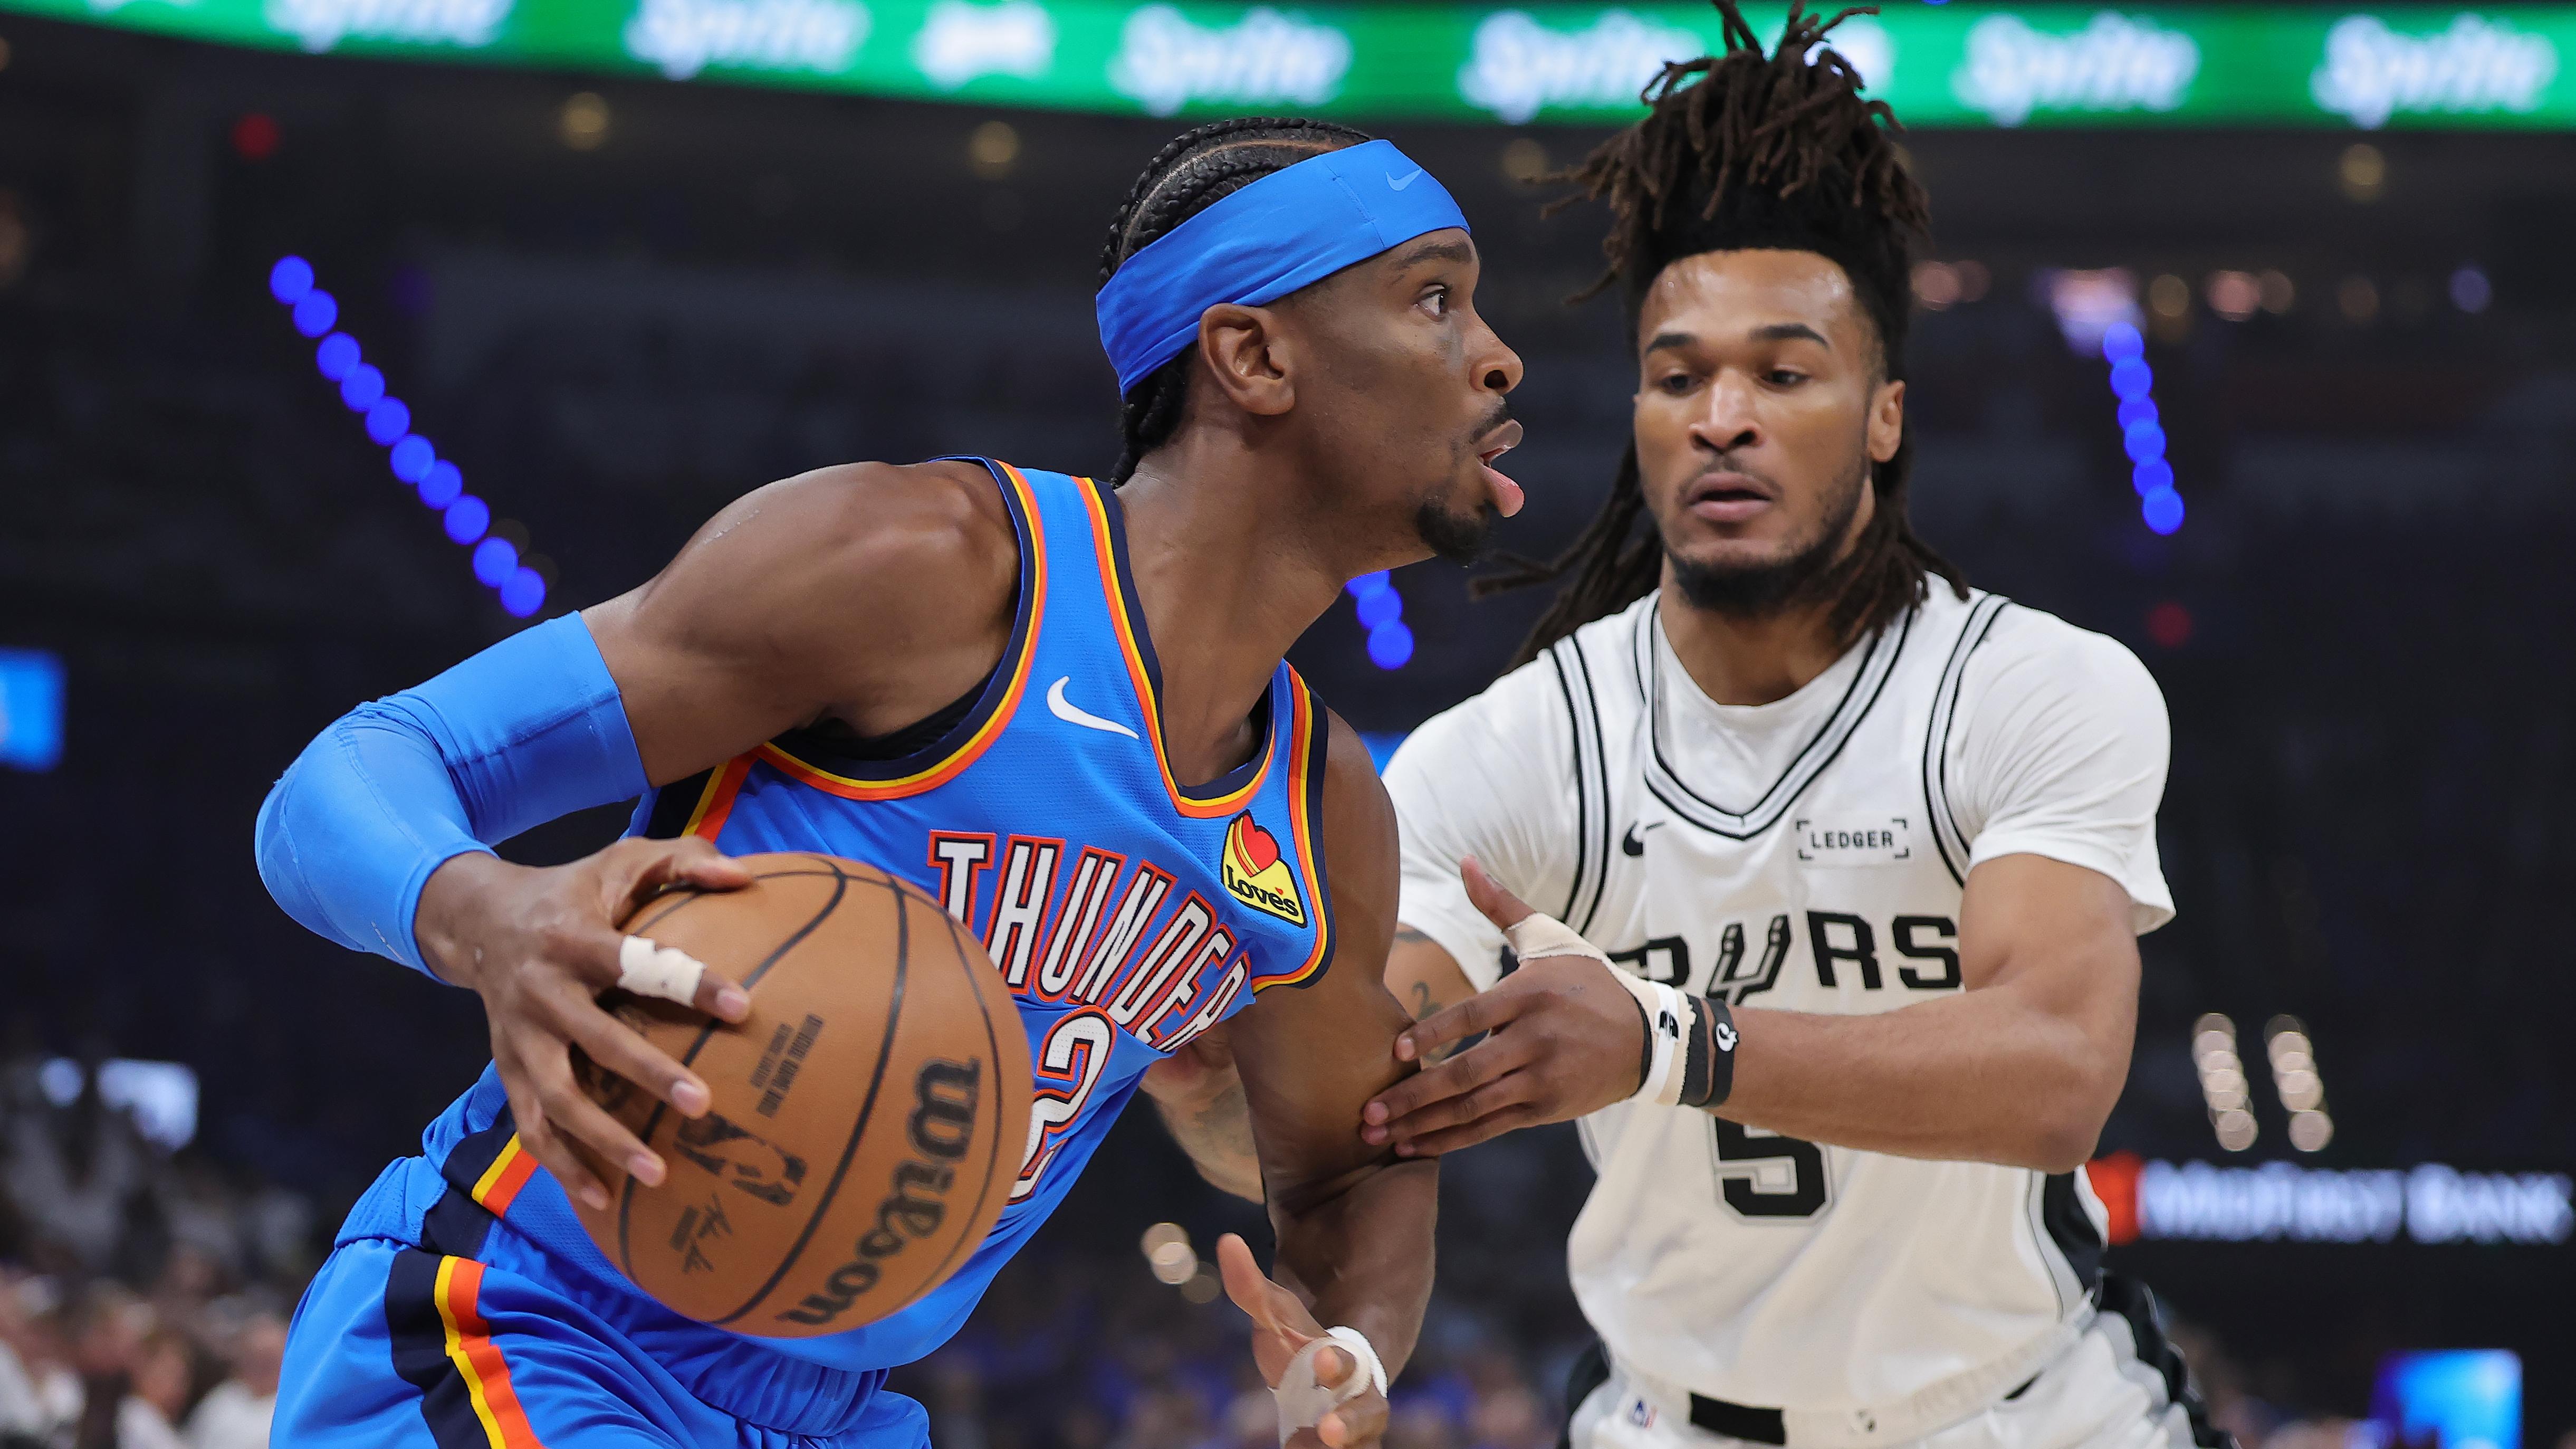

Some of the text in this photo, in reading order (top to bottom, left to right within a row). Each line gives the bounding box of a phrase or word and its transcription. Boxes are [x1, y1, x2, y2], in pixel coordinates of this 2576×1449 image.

[1810, 830, 1894, 849] LEDGER
[927, 830, 1251, 1054] THUNDER
[775, 1057, 981, 1327] Wilson
[997, 1005, 1117, 1205] 2
[1713, 1116, 1826, 1216] 5
